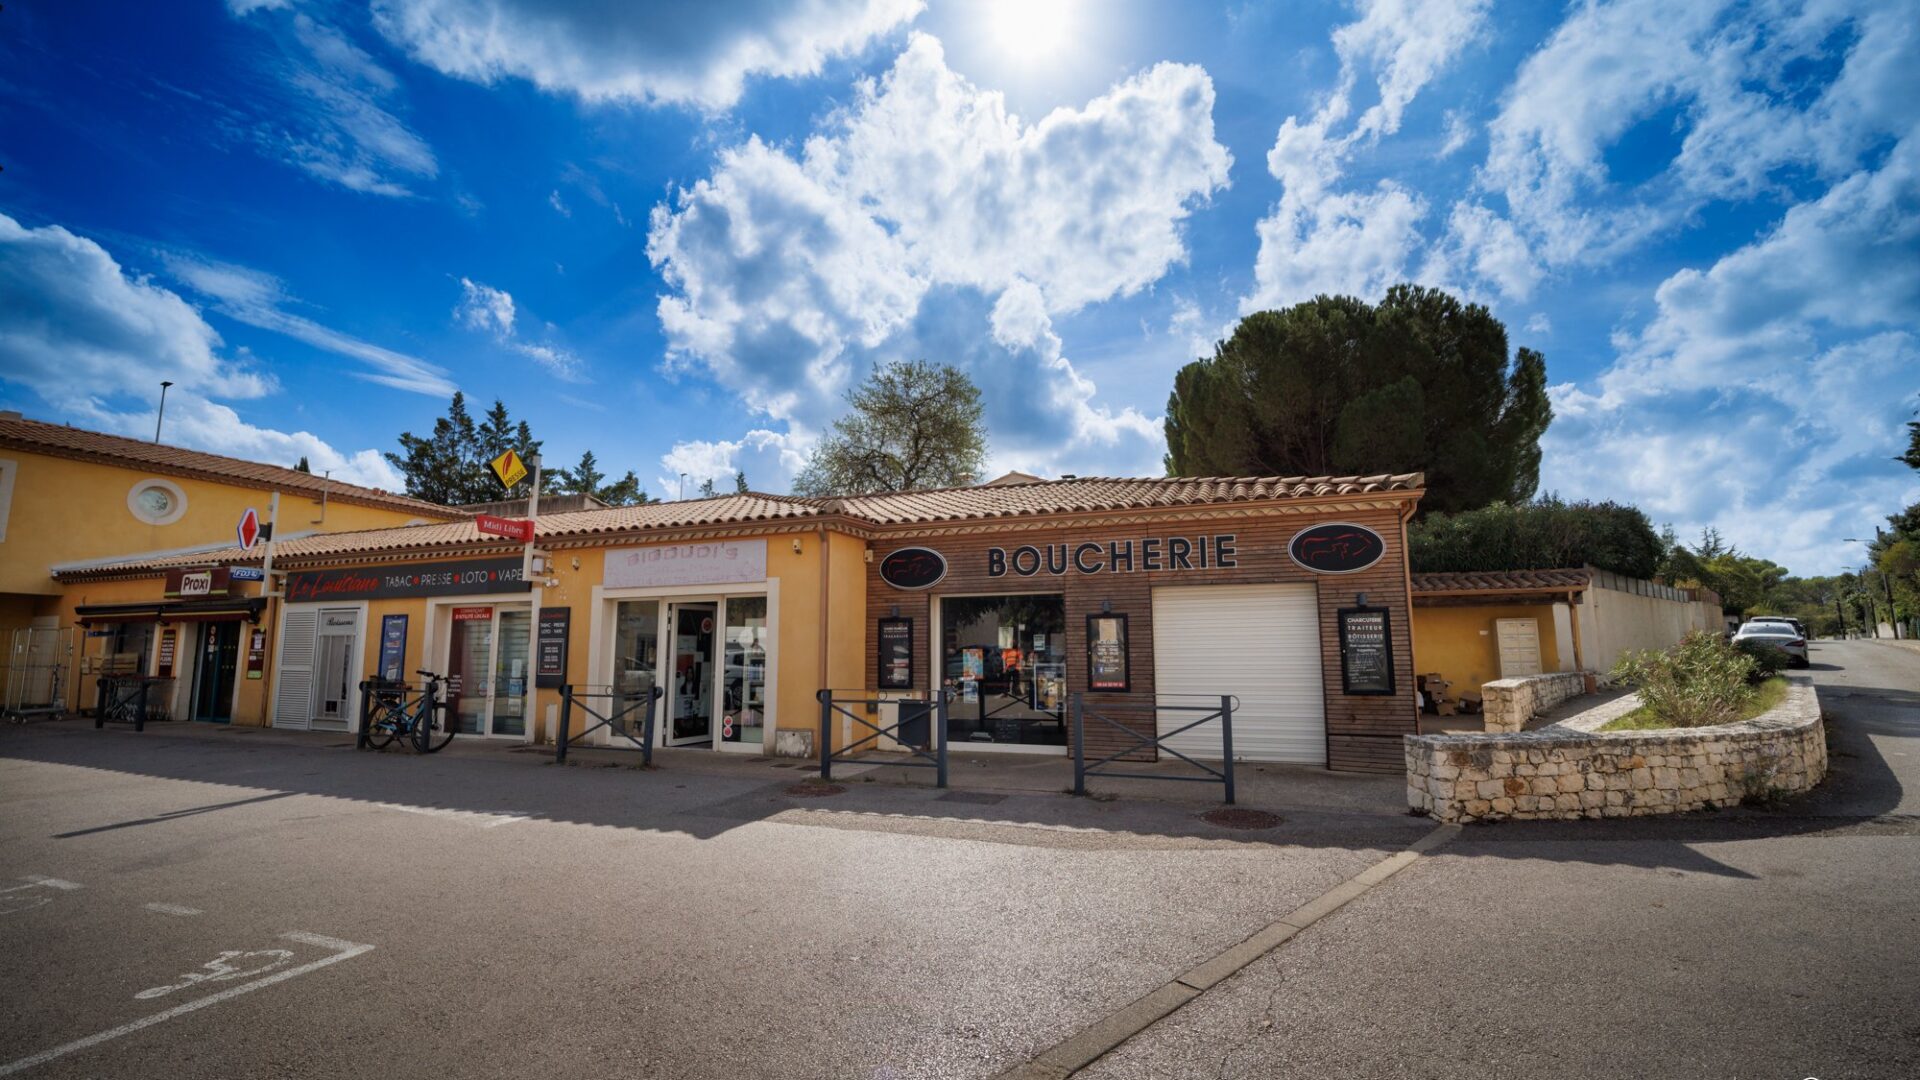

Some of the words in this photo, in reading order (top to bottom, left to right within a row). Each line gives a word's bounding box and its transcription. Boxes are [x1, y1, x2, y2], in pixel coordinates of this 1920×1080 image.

[506, 470, 525, 485] PRESSE
[484, 521, 502, 531] Midi
[504, 524, 524, 533] Libre
[988, 535, 1238, 577] BOUCHERIE
[183, 577, 208, 591] Proxi
[385, 575, 412, 588] TABAC
[421, 573, 452, 586] PRESSE
[461, 571, 488, 584] LOTO
[498, 568, 522, 581] VAPE
